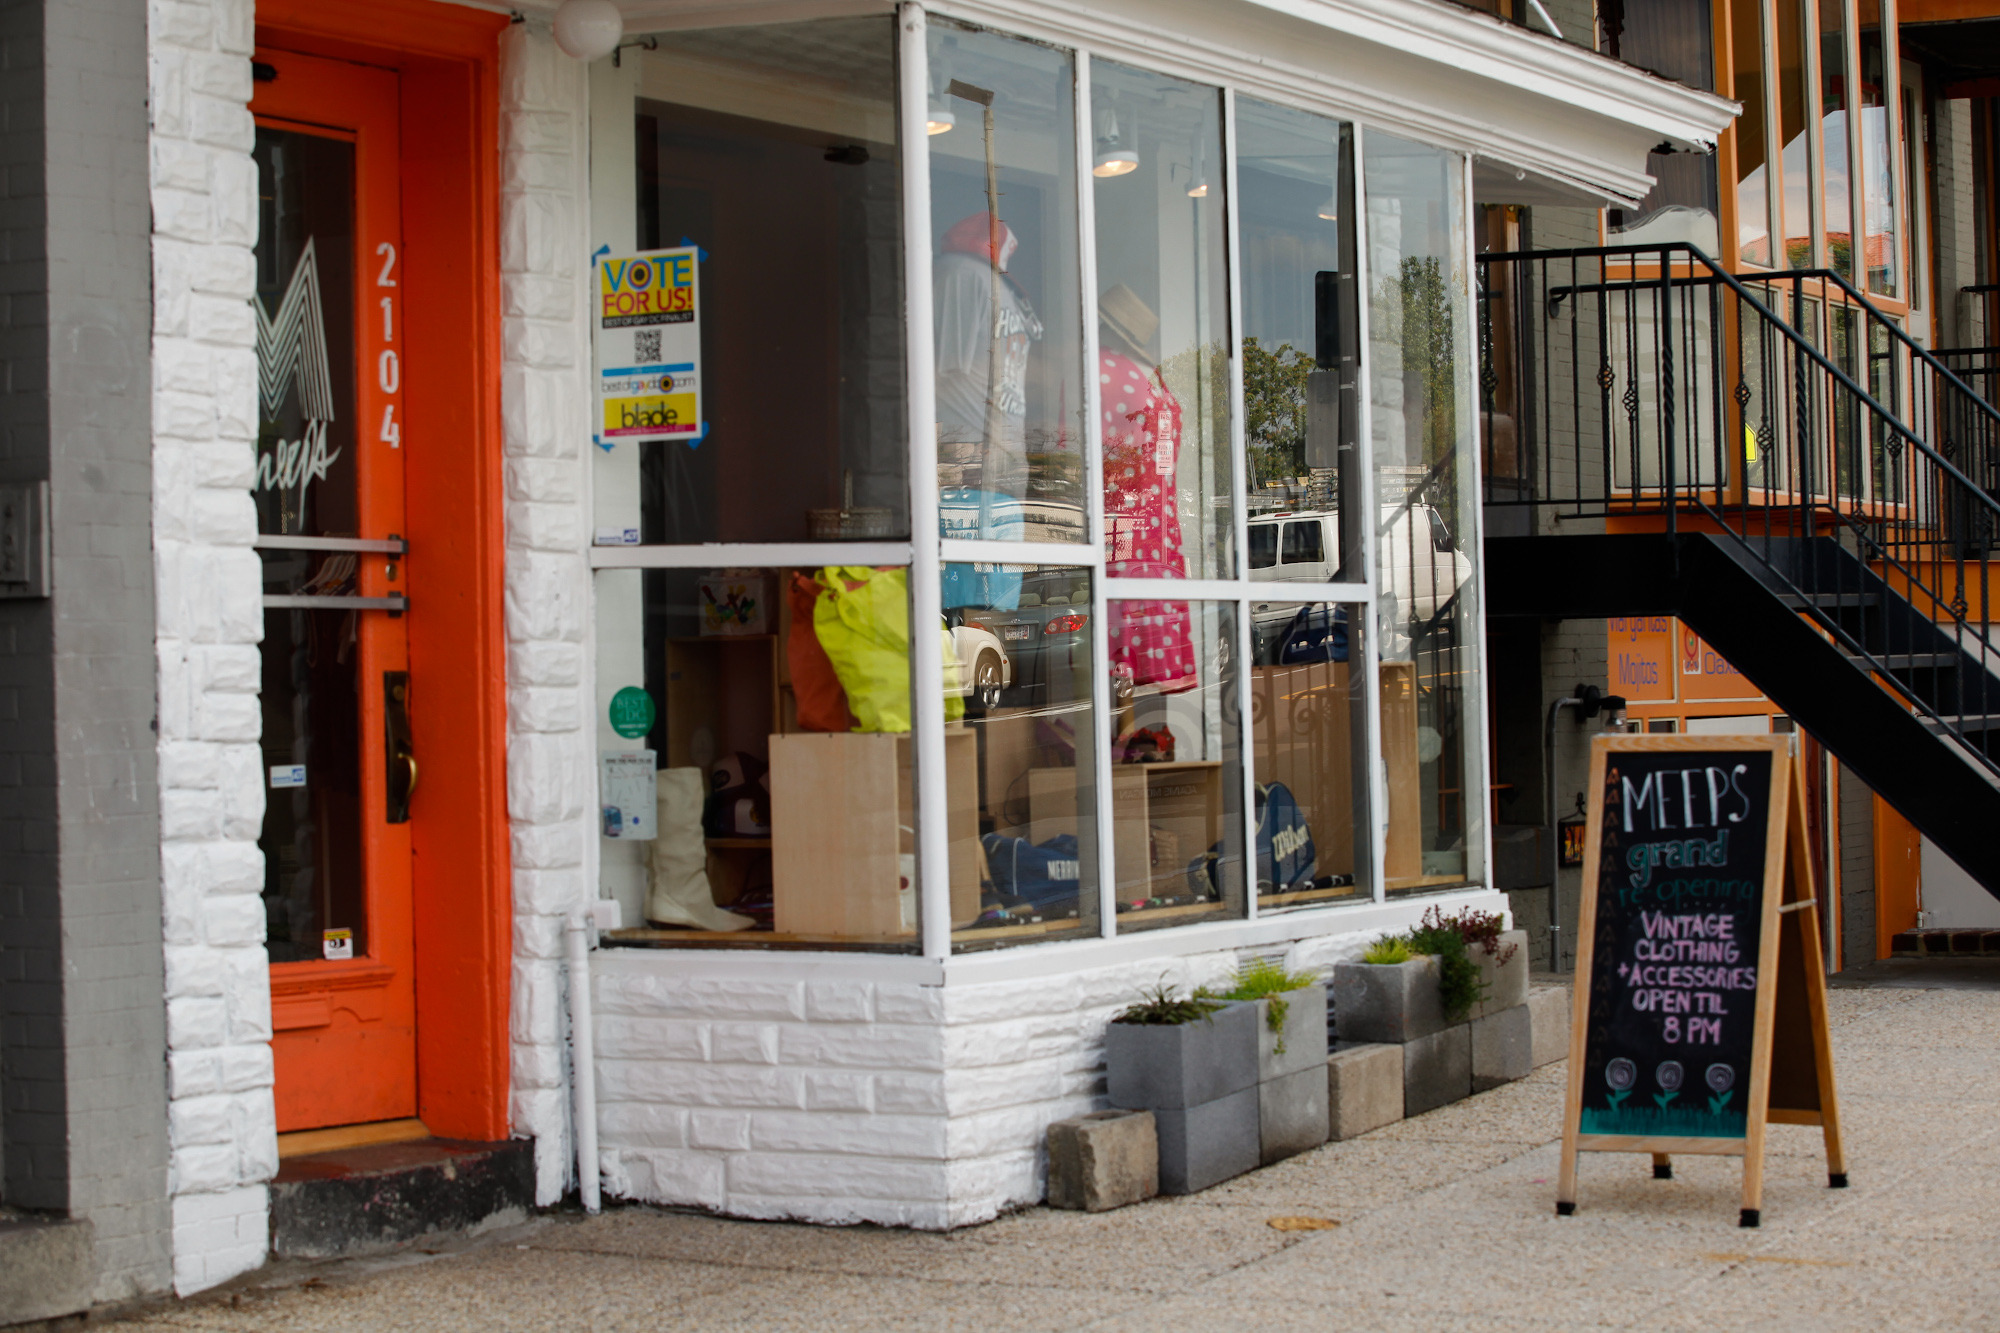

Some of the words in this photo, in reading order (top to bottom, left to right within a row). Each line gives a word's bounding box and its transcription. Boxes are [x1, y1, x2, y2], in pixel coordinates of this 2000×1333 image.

[603, 255, 692, 292] VOTE
[603, 291, 650, 316] FOR
[657, 287, 692, 312] US!
[604, 317, 620, 327] BEST
[633, 315, 648, 325] GAY
[376, 242, 400, 449] 2104
[622, 401, 678, 428] blade
[1618, 652, 1659, 692] Mojitos
[1621, 763, 1750, 833] MEEPS
[1626, 828, 1729, 888] grand
[1618, 877, 1755, 926] re-opening
[1641, 910, 1734, 939] VINTAGE
[1634, 938, 1740, 964] CLOTHING
[1632, 988, 1691, 1013] OPEN
[1693, 991, 1728, 1015] TIL
[1662, 1016, 1681, 1043] 8
[1687, 1016, 1722, 1045] PM
